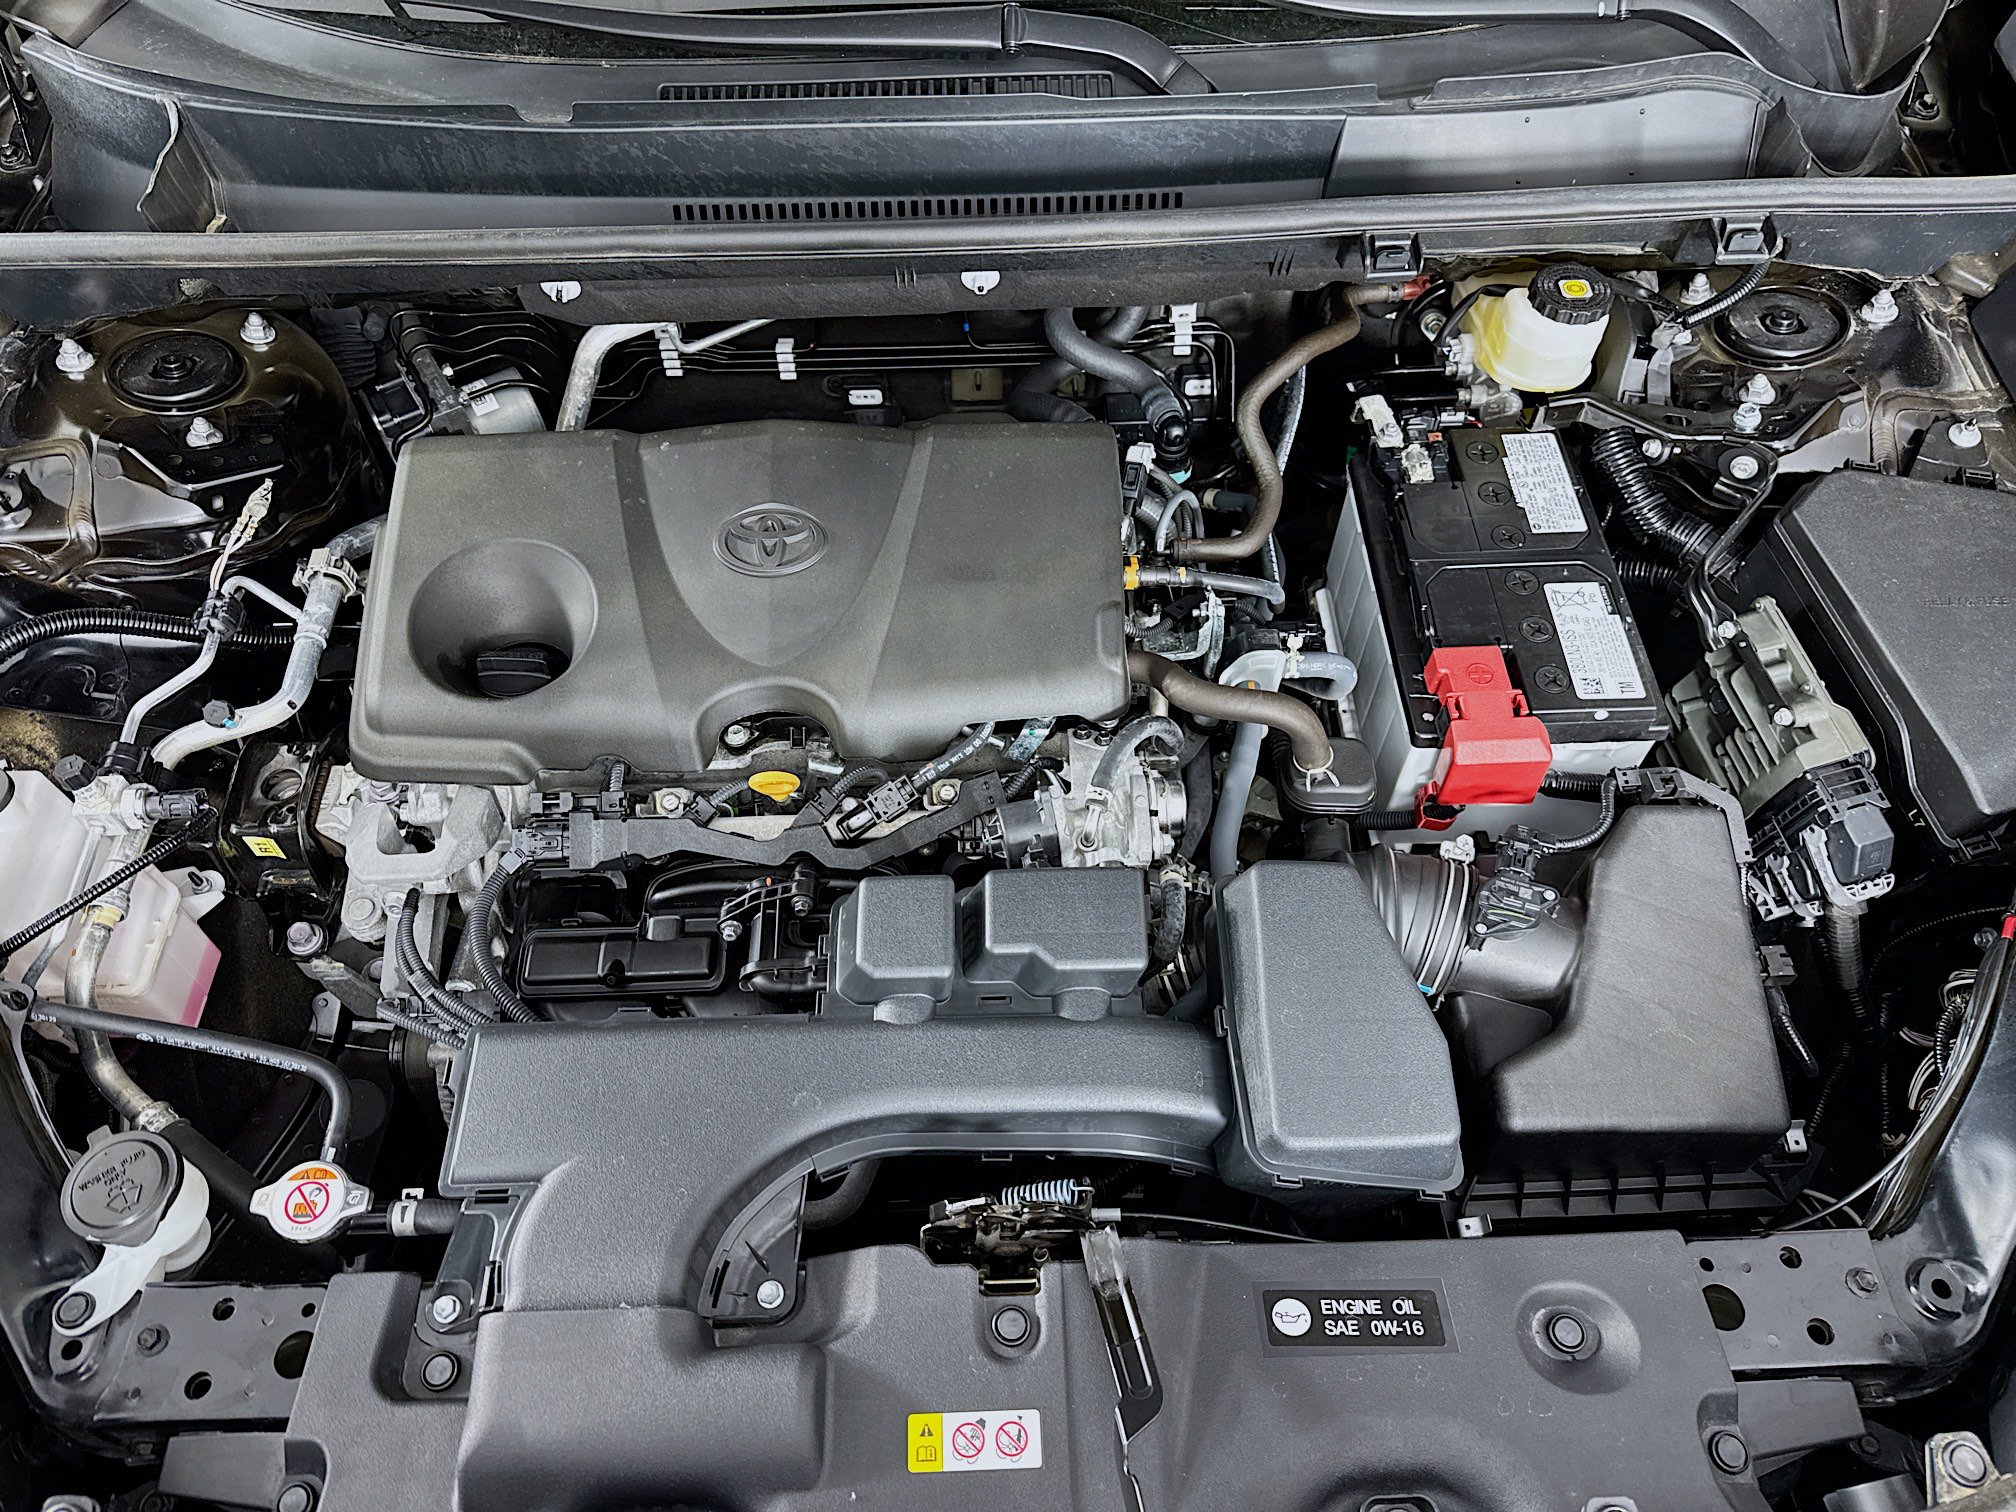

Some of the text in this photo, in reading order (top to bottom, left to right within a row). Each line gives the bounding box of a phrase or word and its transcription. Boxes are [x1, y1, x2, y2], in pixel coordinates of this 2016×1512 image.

[1618, 681, 1636, 694] TM
[1908, 808, 1926, 827] L7
[1320, 1299, 1421, 1315] ENGINE OIL
[1323, 1320, 1424, 1336] SAE 0W-16
